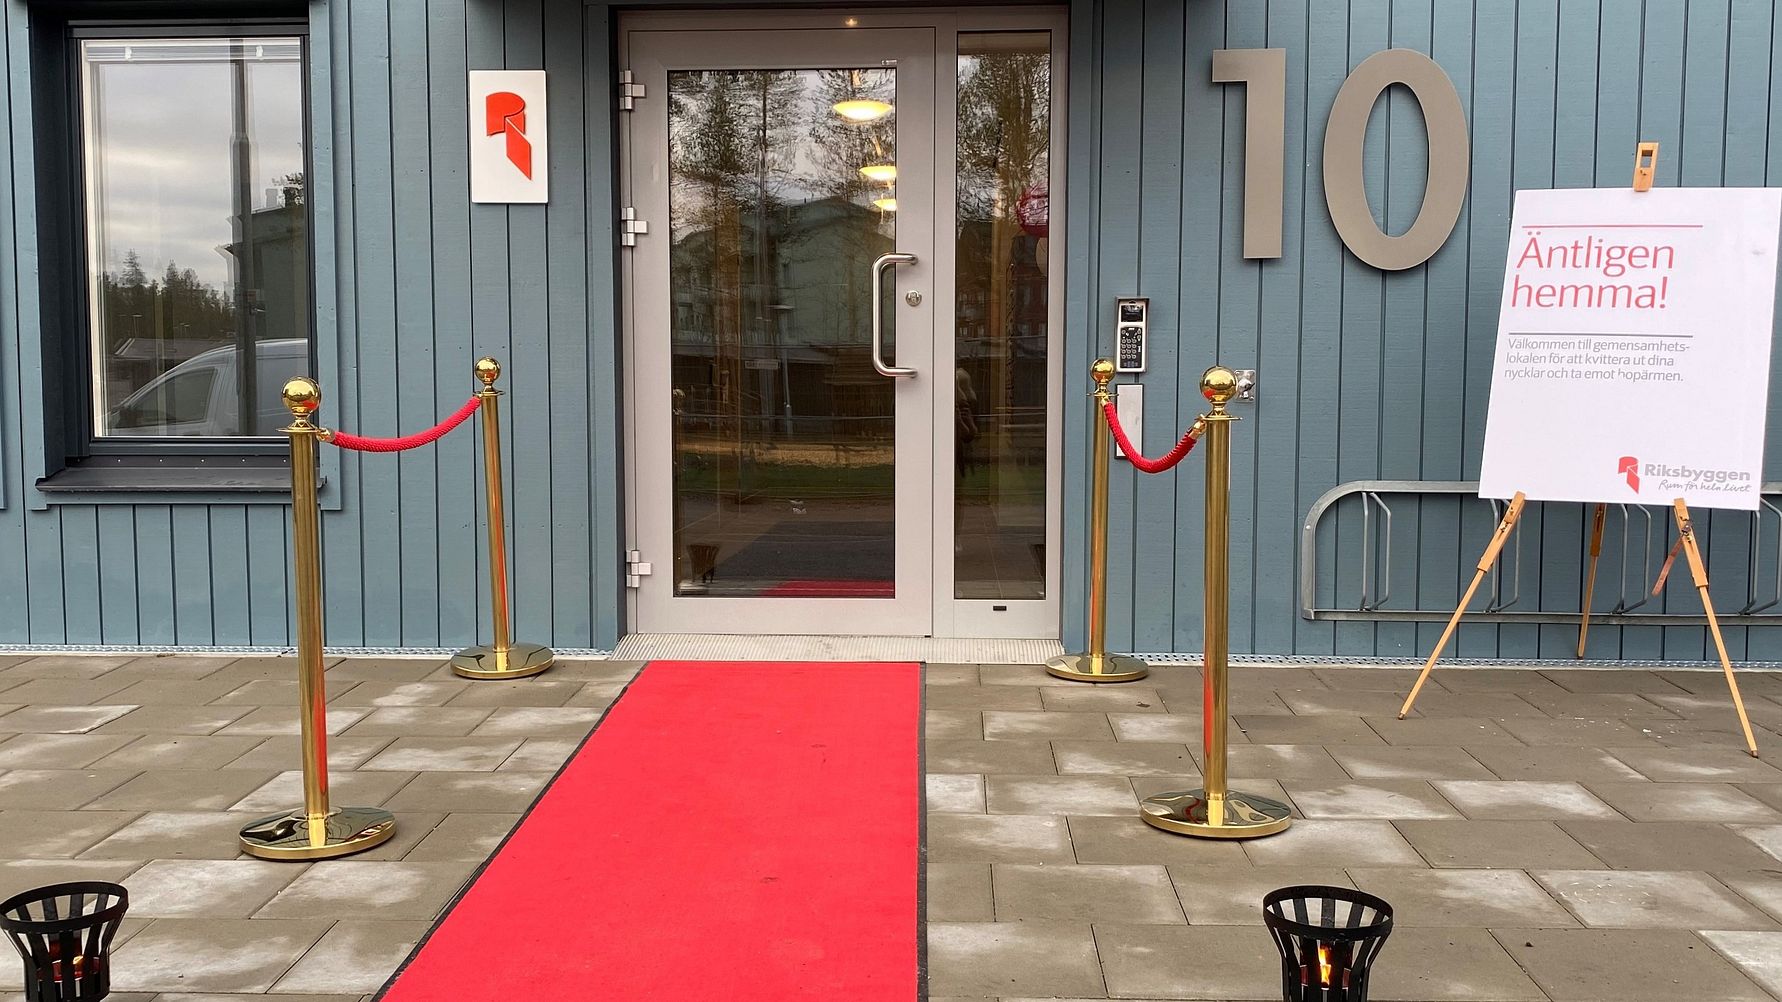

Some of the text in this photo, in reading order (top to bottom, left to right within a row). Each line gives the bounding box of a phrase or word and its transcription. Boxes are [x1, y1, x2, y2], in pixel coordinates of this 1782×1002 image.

[1212, 48, 1470, 270] 10
[1516, 231, 1674, 277] Äntligen
[1512, 274, 1668, 309] hemma!
[1508, 338, 1690, 352] Välkommen till gemensamhets-
[1506, 352, 1674, 366] lokalen för att kvittera ut dina
[1504, 366, 1545, 381] nycklar
[1547, 367, 1568, 379] och
[1571, 369, 1582, 379] ta
[1584, 369, 1616, 380] emot
[1644, 464, 1751, 483] Riksbyggen
[1658, 479, 1683, 490] Rum
[1685, 481, 1698, 492] för
[1722, 483, 1752, 493] livet
